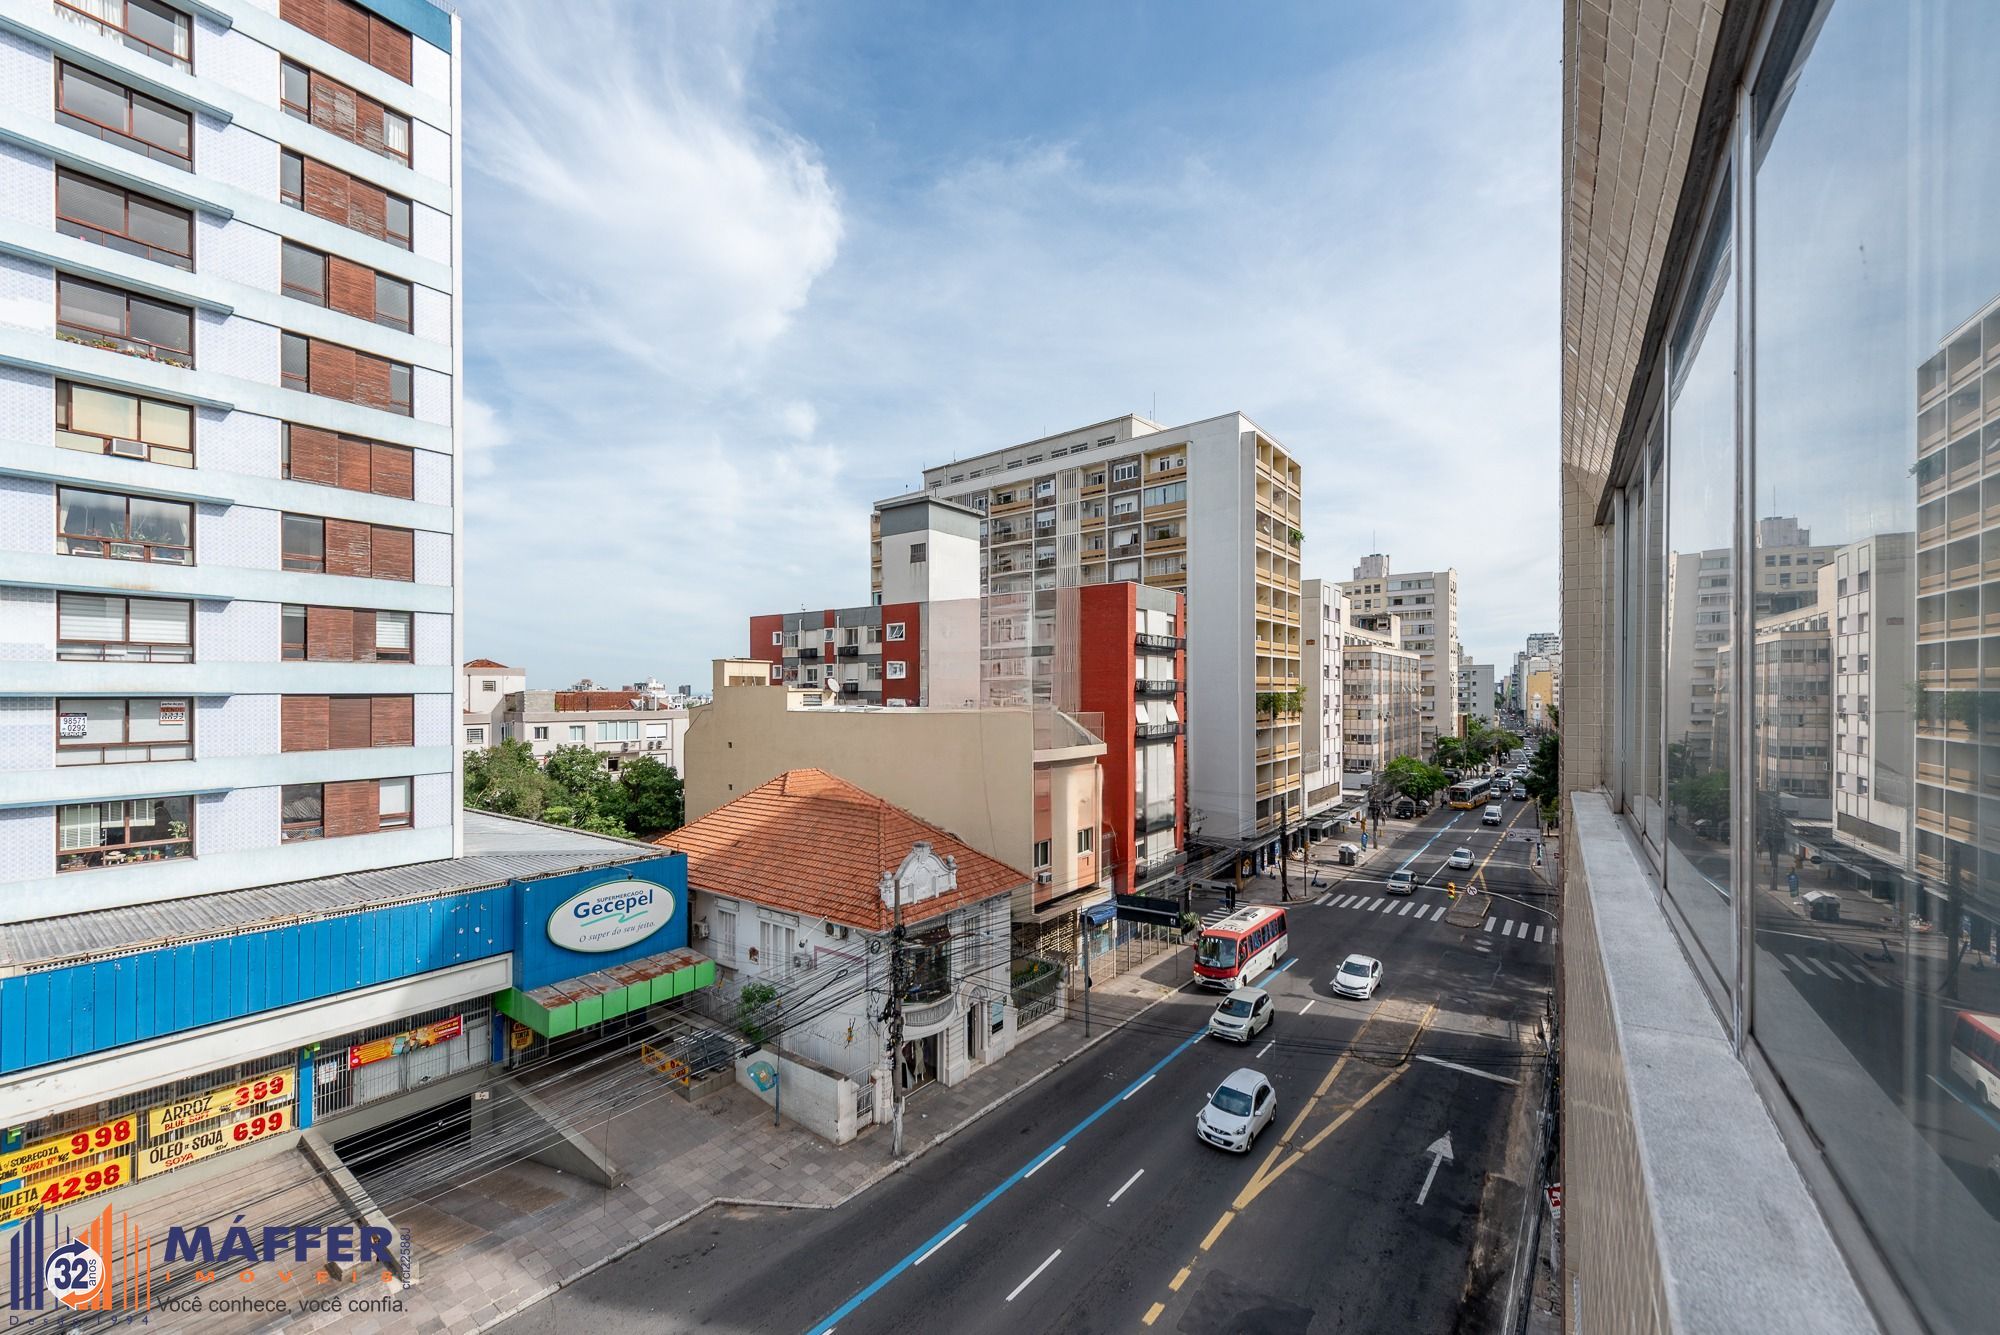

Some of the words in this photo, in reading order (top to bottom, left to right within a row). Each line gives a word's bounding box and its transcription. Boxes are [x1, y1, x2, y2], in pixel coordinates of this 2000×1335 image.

[63, 717, 86, 725] 98571
[67, 724, 86, 732] 0292
[573, 889, 653, 919] Gecepel
[596, 889, 644, 903] SUPERMERCADO
[579, 935, 587, 943] O
[588, 931, 610, 942] super
[611, 927, 622, 936] do
[623, 925, 635, 933] seu
[635, 920, 656, 933] jeito.
[161, 1096, 214, 1125] ARROZ
[164, 1119, 185, 1132] BLUE
[10, 1145, 59, 1168] SOBRECOXA
[149, 1140, 183, 1164] ÓLEO
[191, 1129, 223, 1151] SOJA
[164, 1152, 194, 1168] SOYA
[0, 1187, 38, 1211] ULETA
